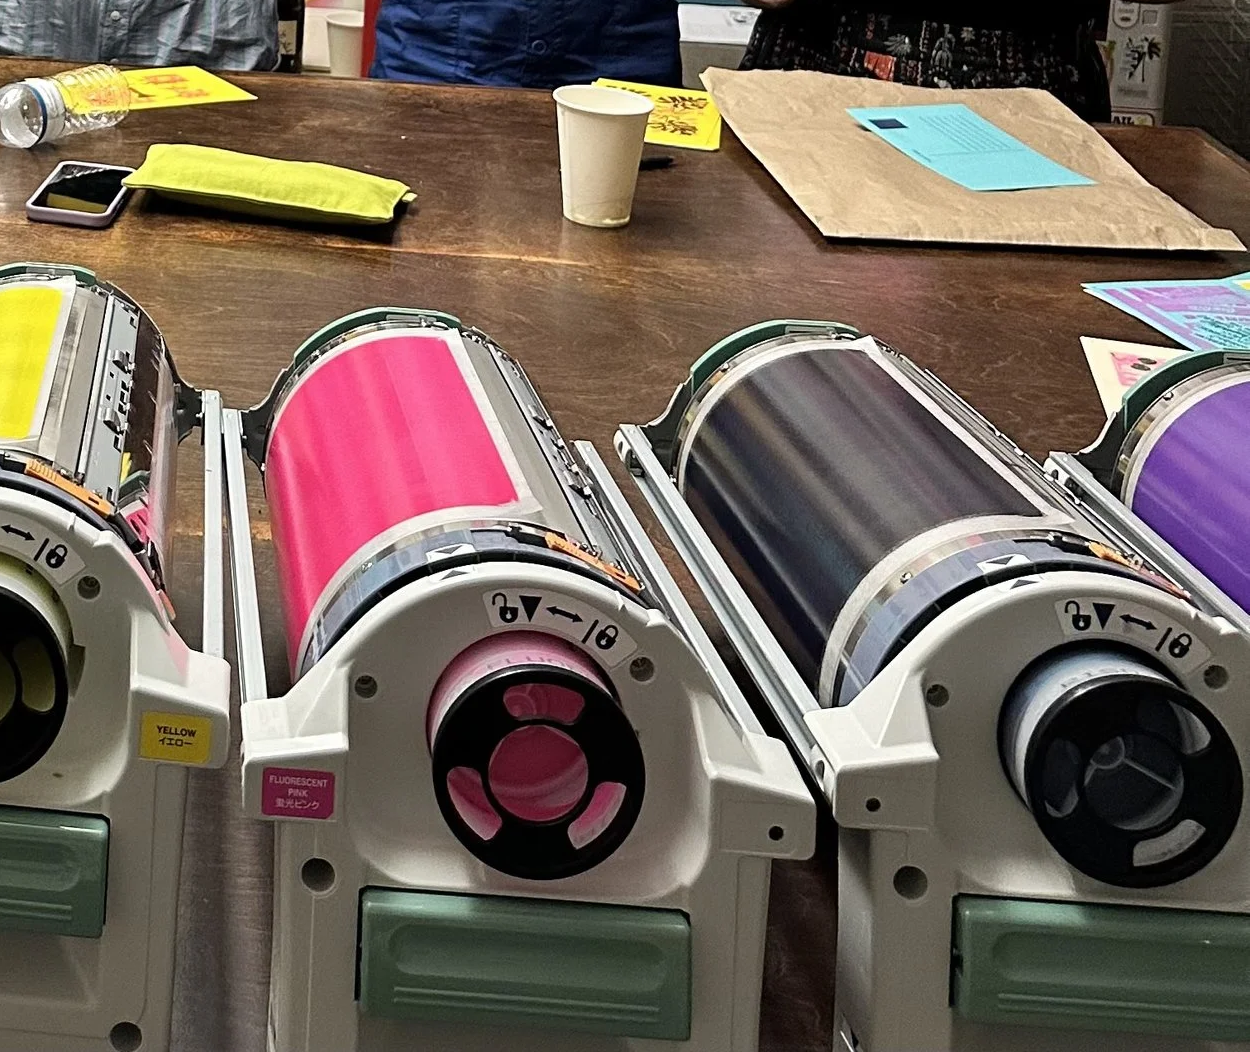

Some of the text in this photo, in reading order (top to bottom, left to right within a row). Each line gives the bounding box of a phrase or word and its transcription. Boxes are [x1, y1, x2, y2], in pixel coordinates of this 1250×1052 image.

[156, 725, 197, 737] YELLOW
[158, 737, 193, 747] イエロー
[269, 775, 328, 787] FLUORESCENT
[288, 788, 308, 797] PINK
